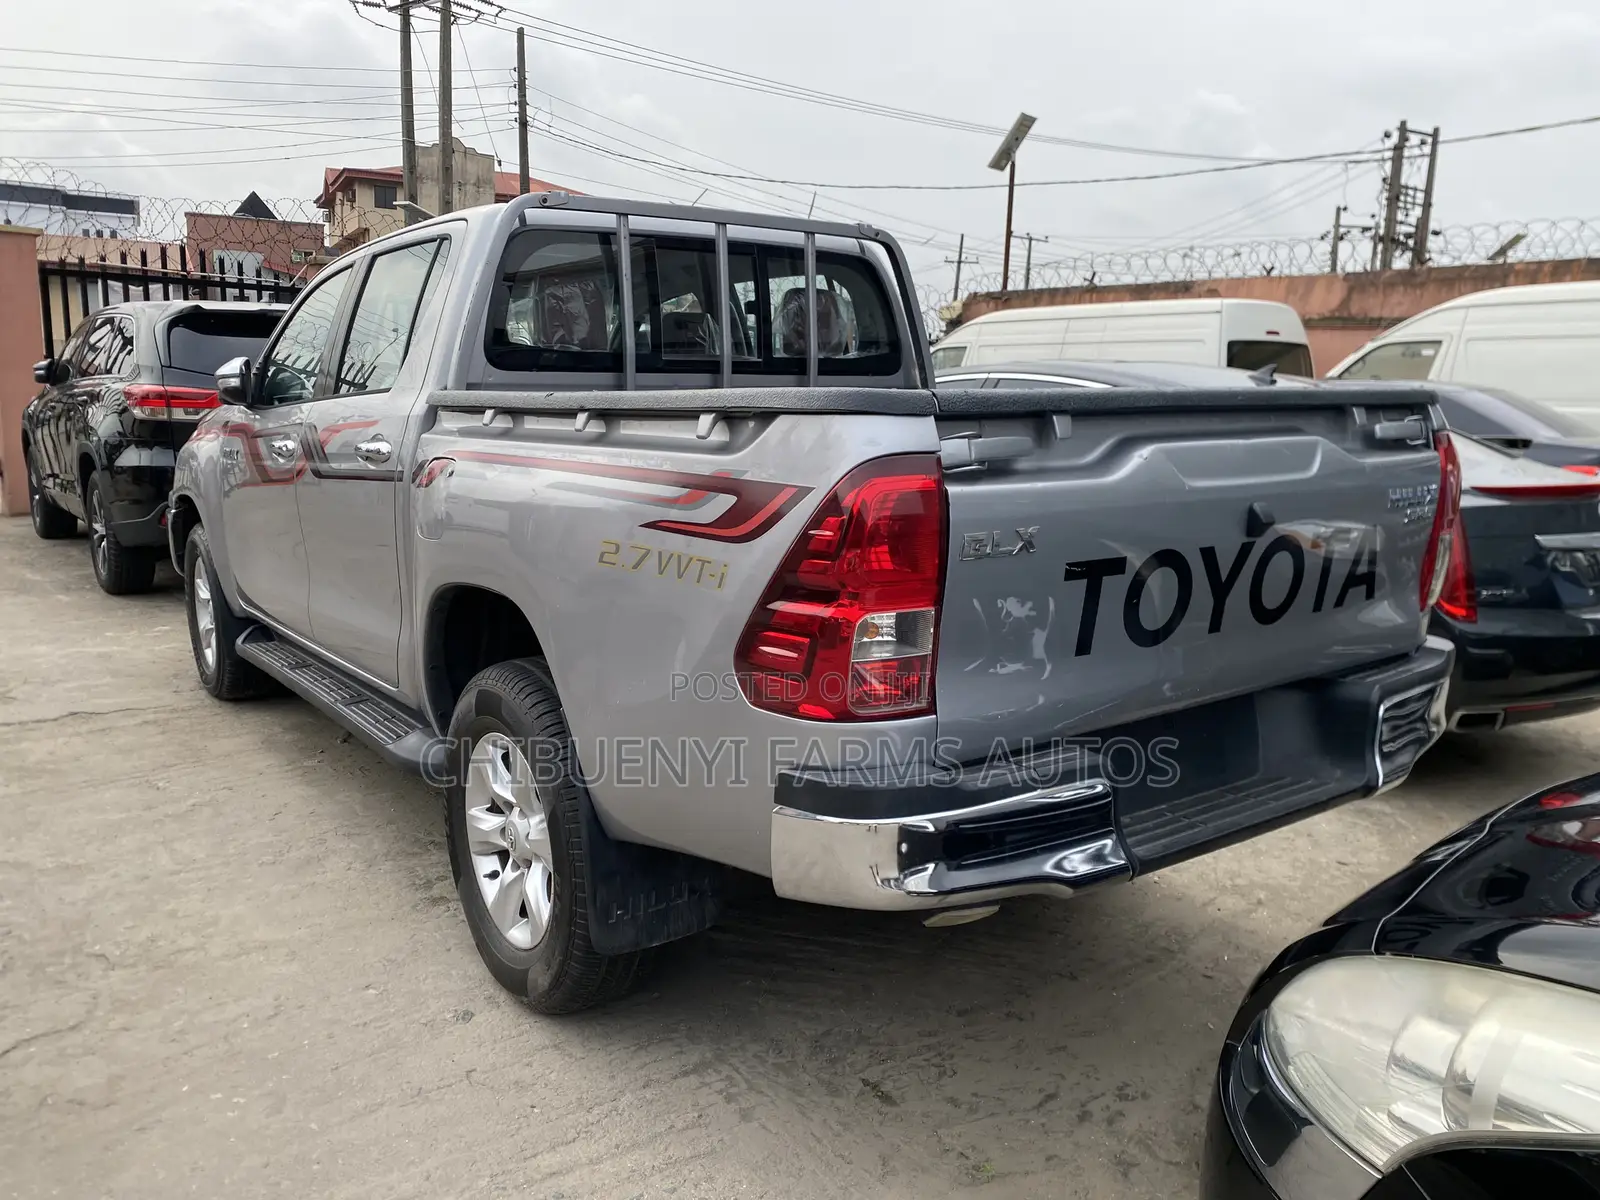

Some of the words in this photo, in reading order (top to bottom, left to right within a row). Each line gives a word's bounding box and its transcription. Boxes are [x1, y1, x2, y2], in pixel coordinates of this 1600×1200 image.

[598, 540, 651, 571] 2.7
[656, 549, 728, 590] VVT-i
[959, 526, 1040, 561] GLX
[1063, 525, 1379, 657] TOYOTA
